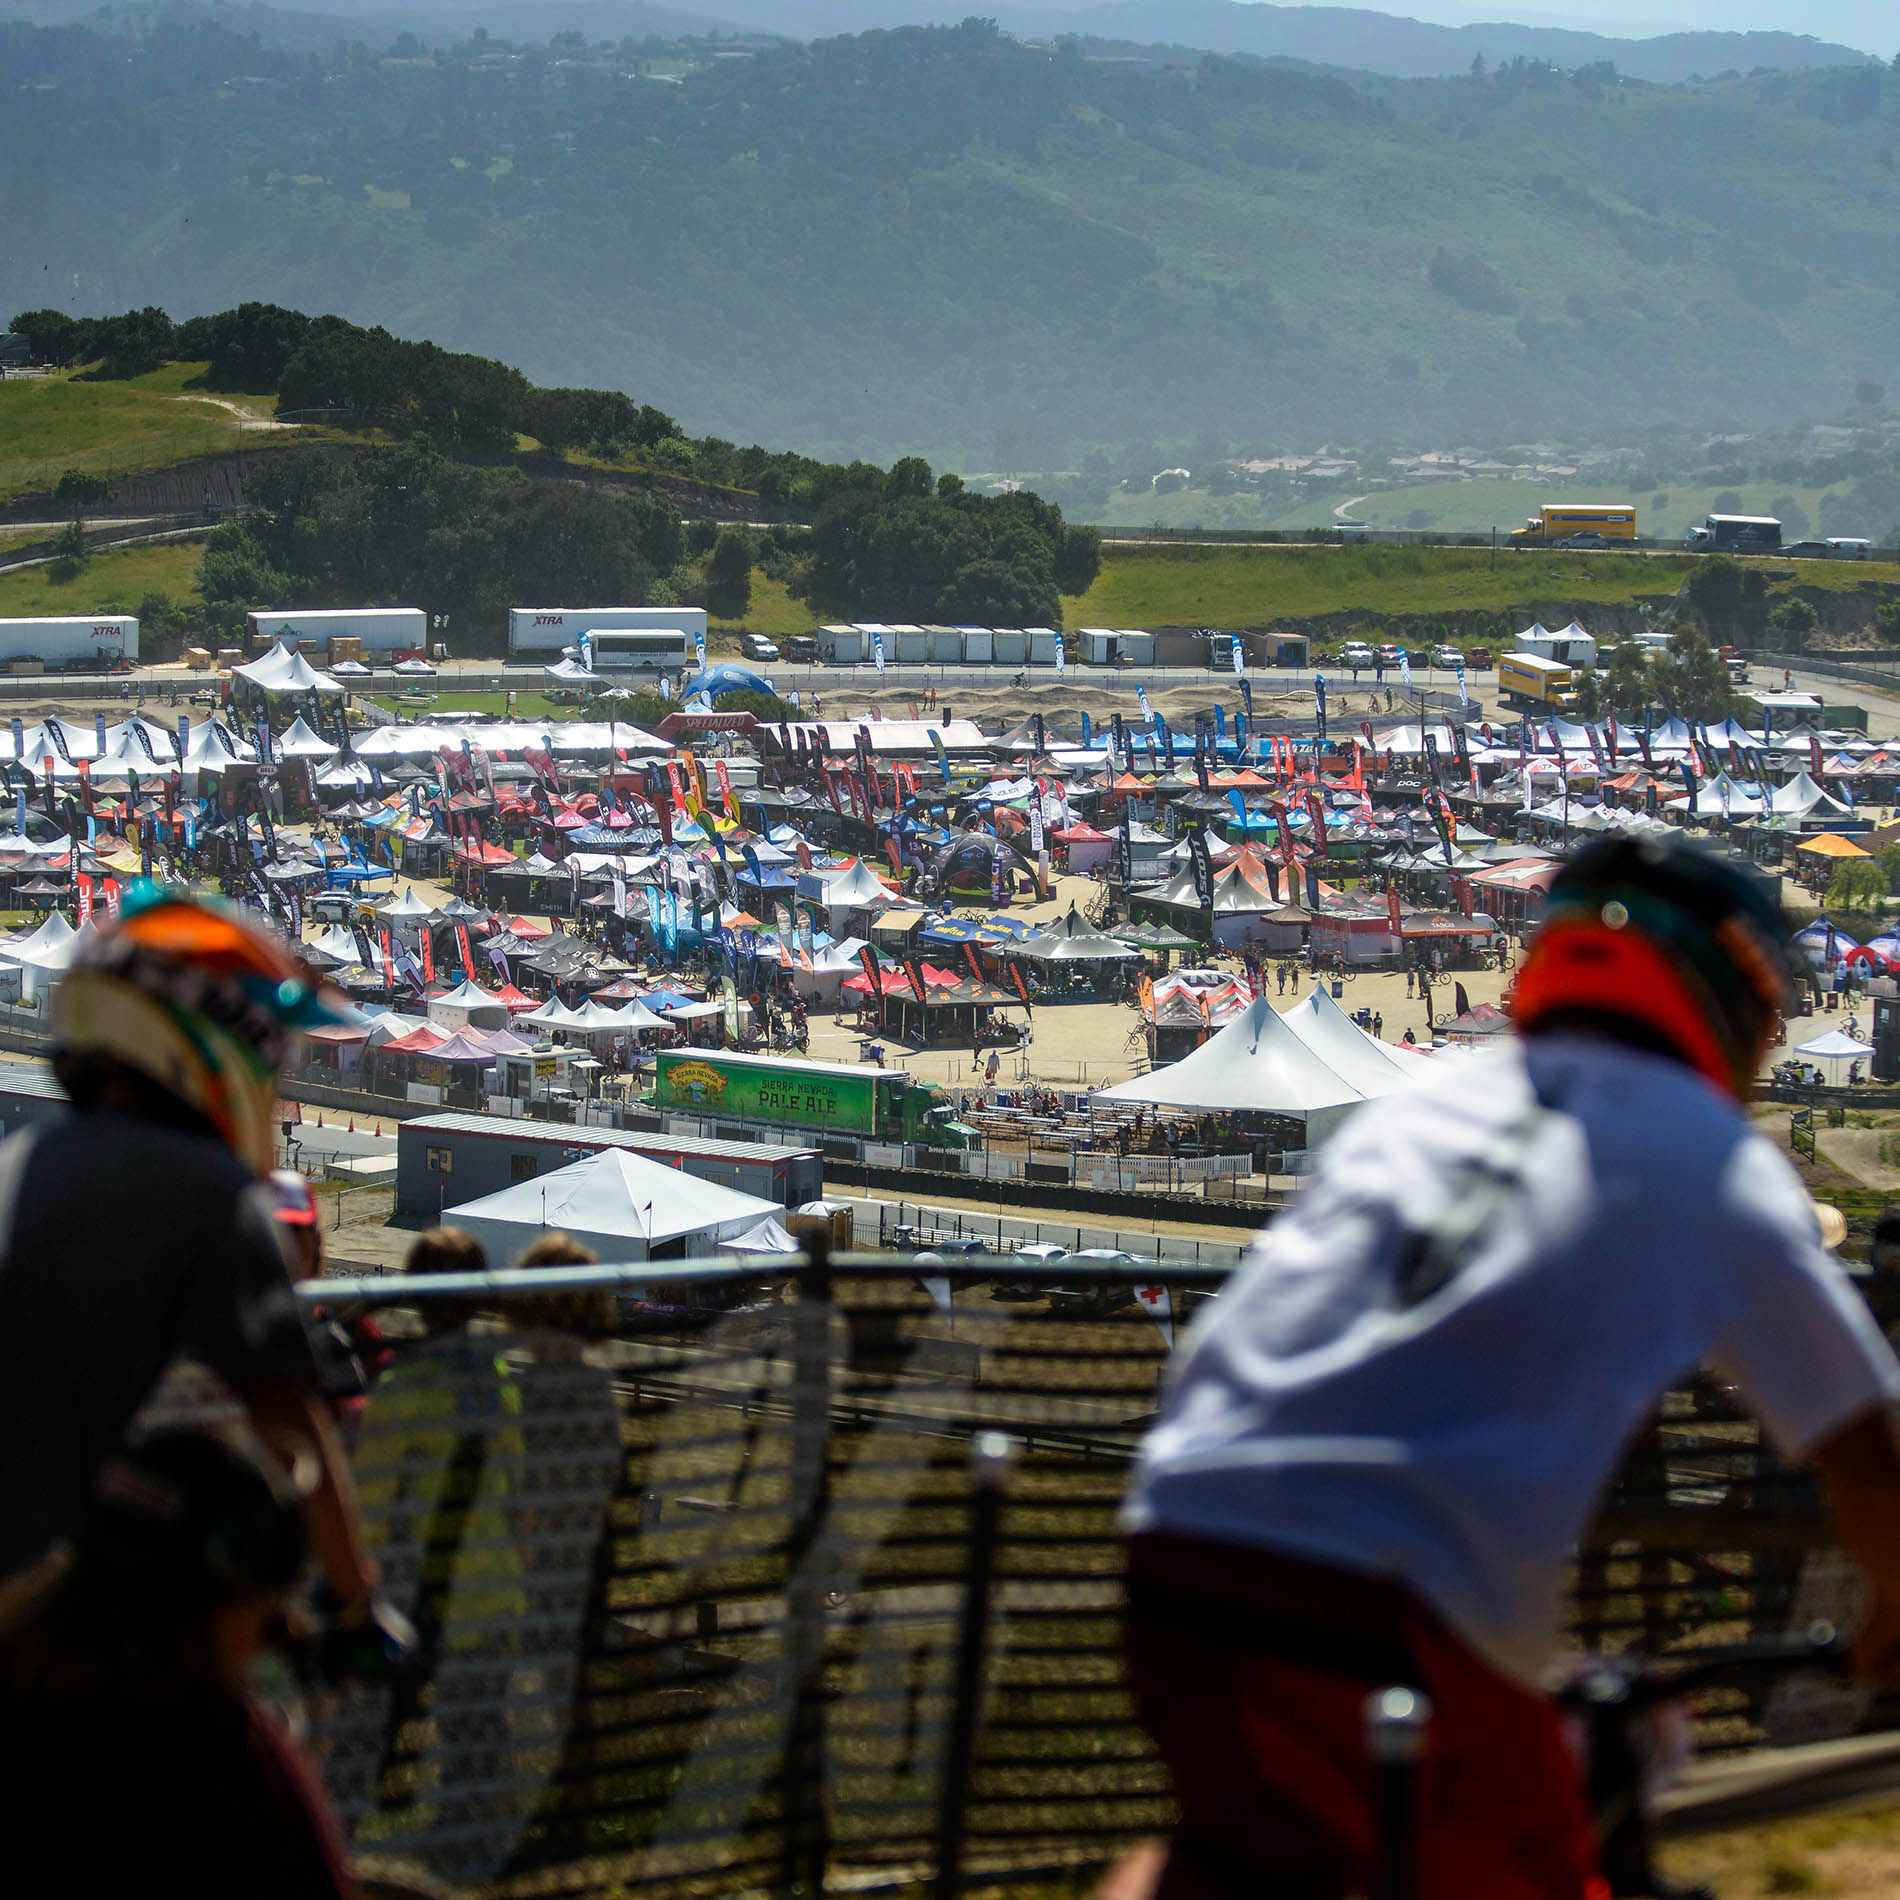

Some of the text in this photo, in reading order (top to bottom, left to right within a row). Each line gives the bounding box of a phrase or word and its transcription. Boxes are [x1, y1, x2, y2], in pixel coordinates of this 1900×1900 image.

[531, 615, 564, 628] XTRA
[90, 626, 121, 638] XTRA
[686, 717, 745, 728] SPECIALIZED
[859, 948, 881, 989] mongoose
[903, 960, 925, 1001] mongoose
[725, 987, 736, 1027] ATM
[675, 1069, 719, 1085] SIERRA NEVADA
[761, 1079, 834, 1097] SIERRA NEVADA
[758, 1090, 837, 1115] PALE ALE
